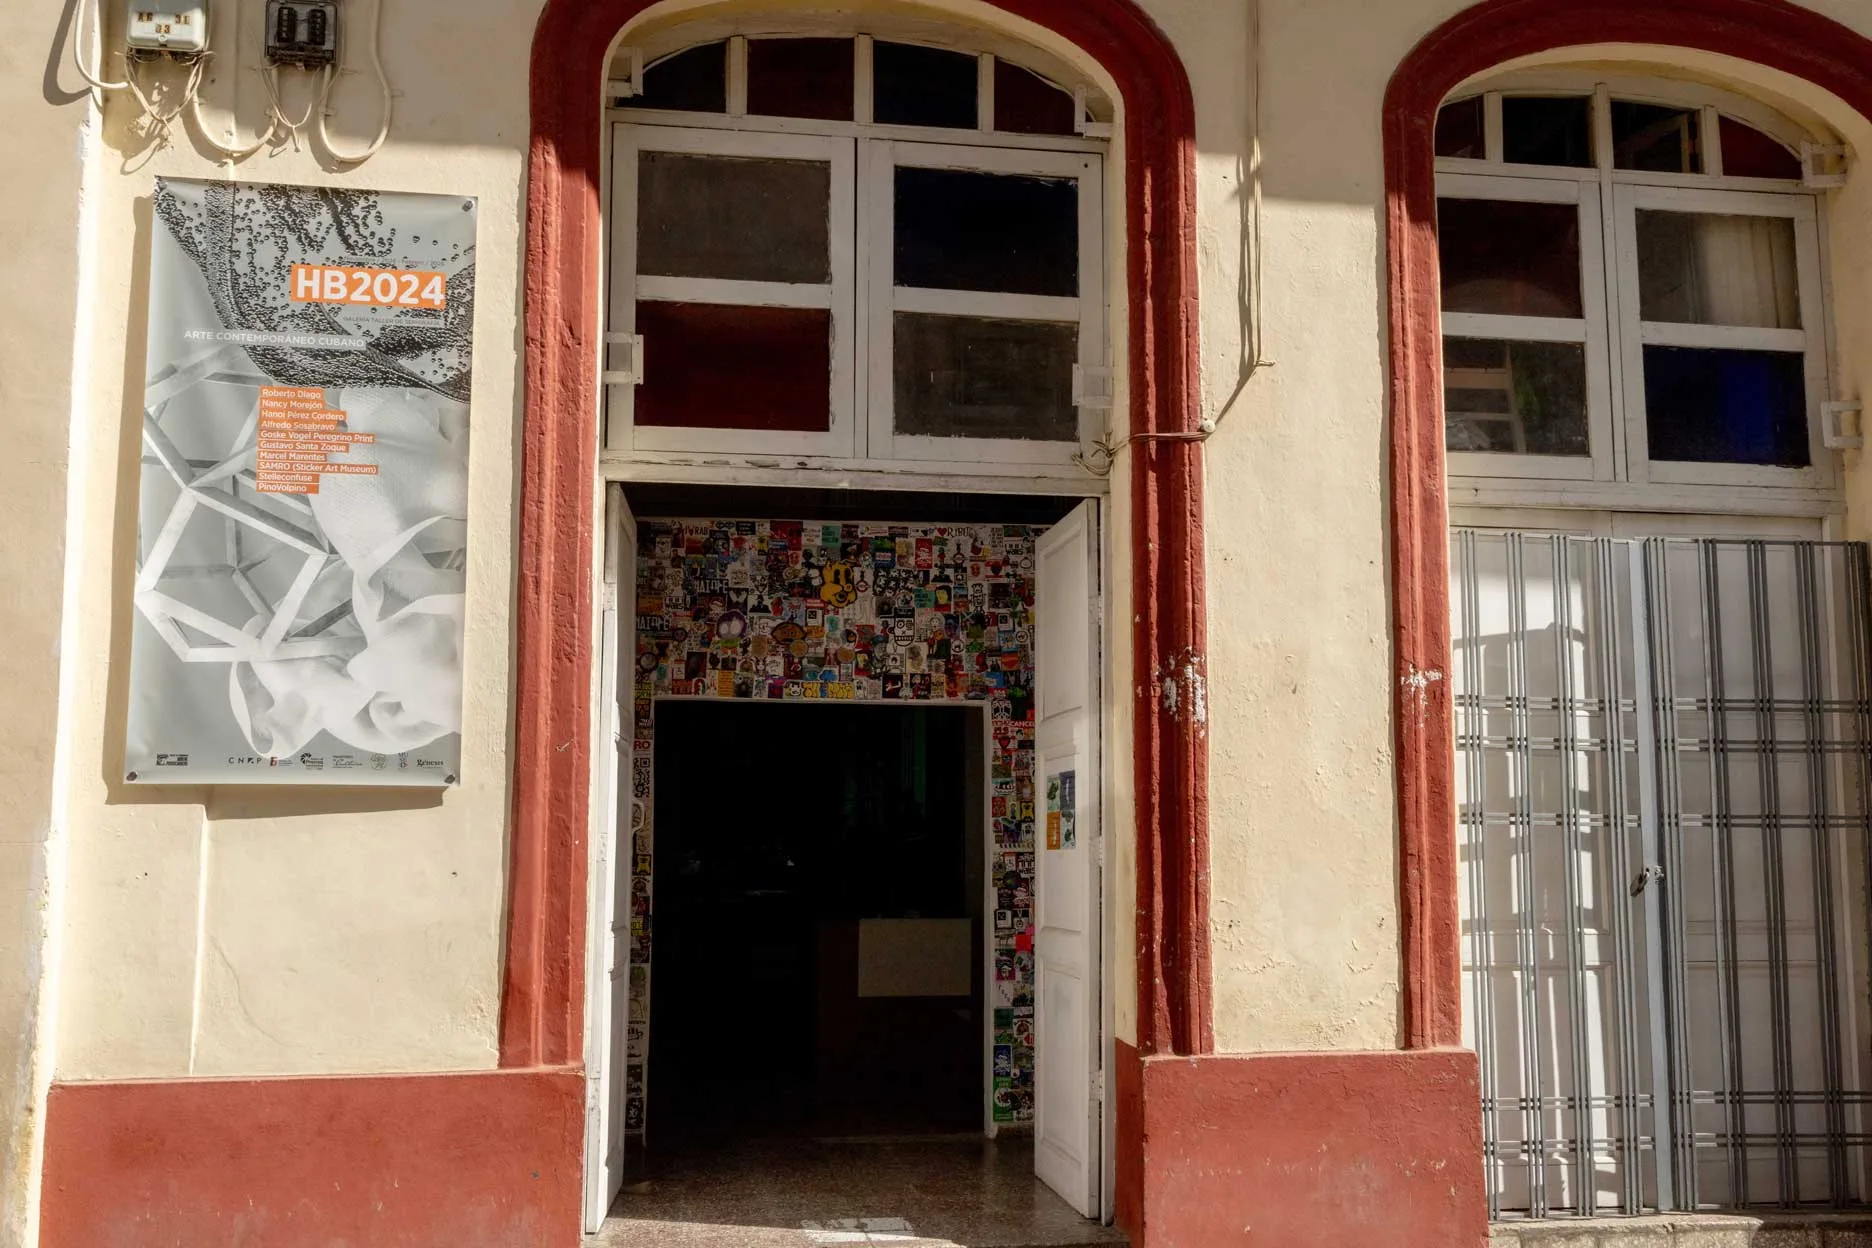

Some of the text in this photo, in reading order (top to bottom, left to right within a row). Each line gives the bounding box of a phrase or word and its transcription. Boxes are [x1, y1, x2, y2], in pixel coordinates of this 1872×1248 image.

[297, 268, 445, 306] HB2024
[184, 330, 213, 340] ARTE
[318, 337, 365, 347] CUBANO
[262, 389, 321, 399] Roberto Diago
[262, 399, 288, 409] Nancy
[312, 412, 344, 420] Cordero
[261, 420, 335, 430] Alfredo Sosabravo
[313, 433, 352, 442] Peregrino
[354, 434, 373, 443] Print
[260, 440, 293, 449] Gustavo
[295, 441, 318, 450] Santa
[260, 451, 287, 459] Marcel
[259, 461, 377, 474] SAMRO (Sticker Art Museum)
